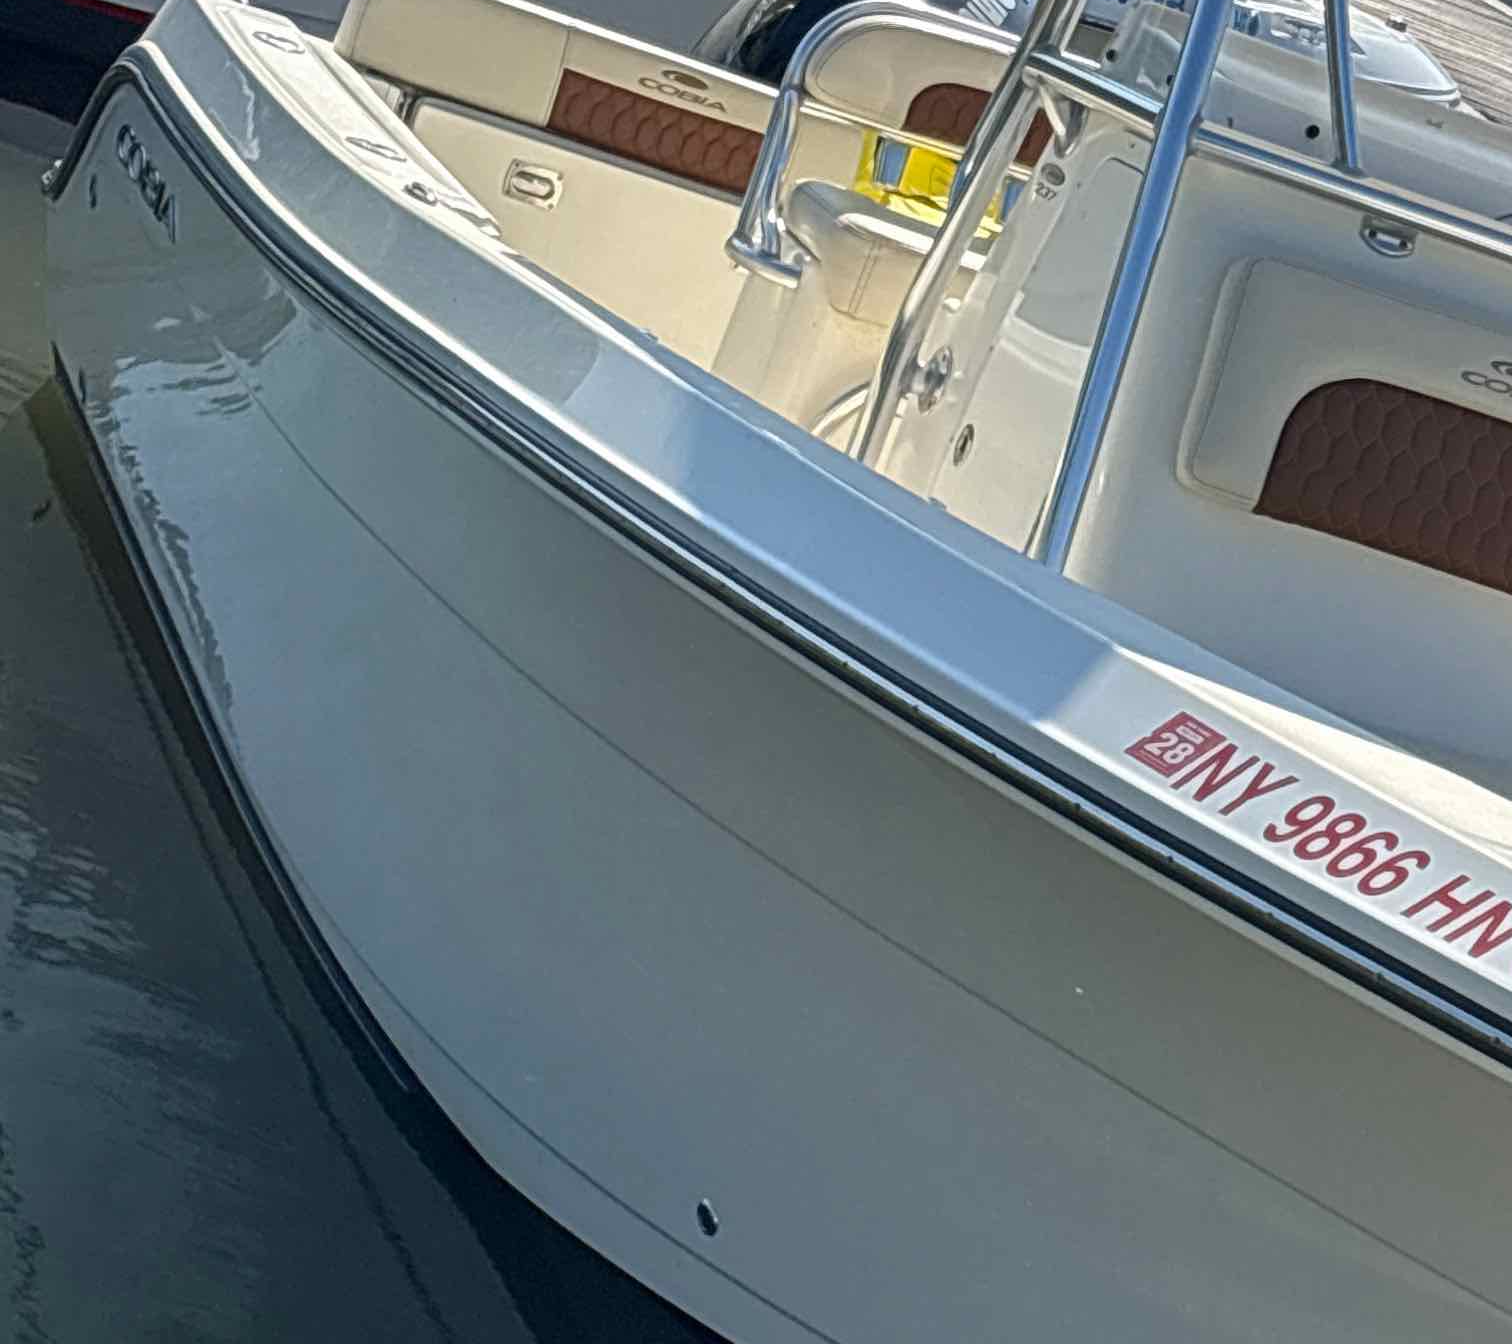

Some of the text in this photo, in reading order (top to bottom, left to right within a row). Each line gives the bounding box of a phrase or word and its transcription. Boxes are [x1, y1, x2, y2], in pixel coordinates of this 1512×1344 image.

[638, 77, 727, 113] COBIA
[117, 123, 176, 245] COBIA
[1143, 732, 1195, 765] 28
[1168, 742, 1300, 817] NY
[1262, 794, 1431, 897] 9866
